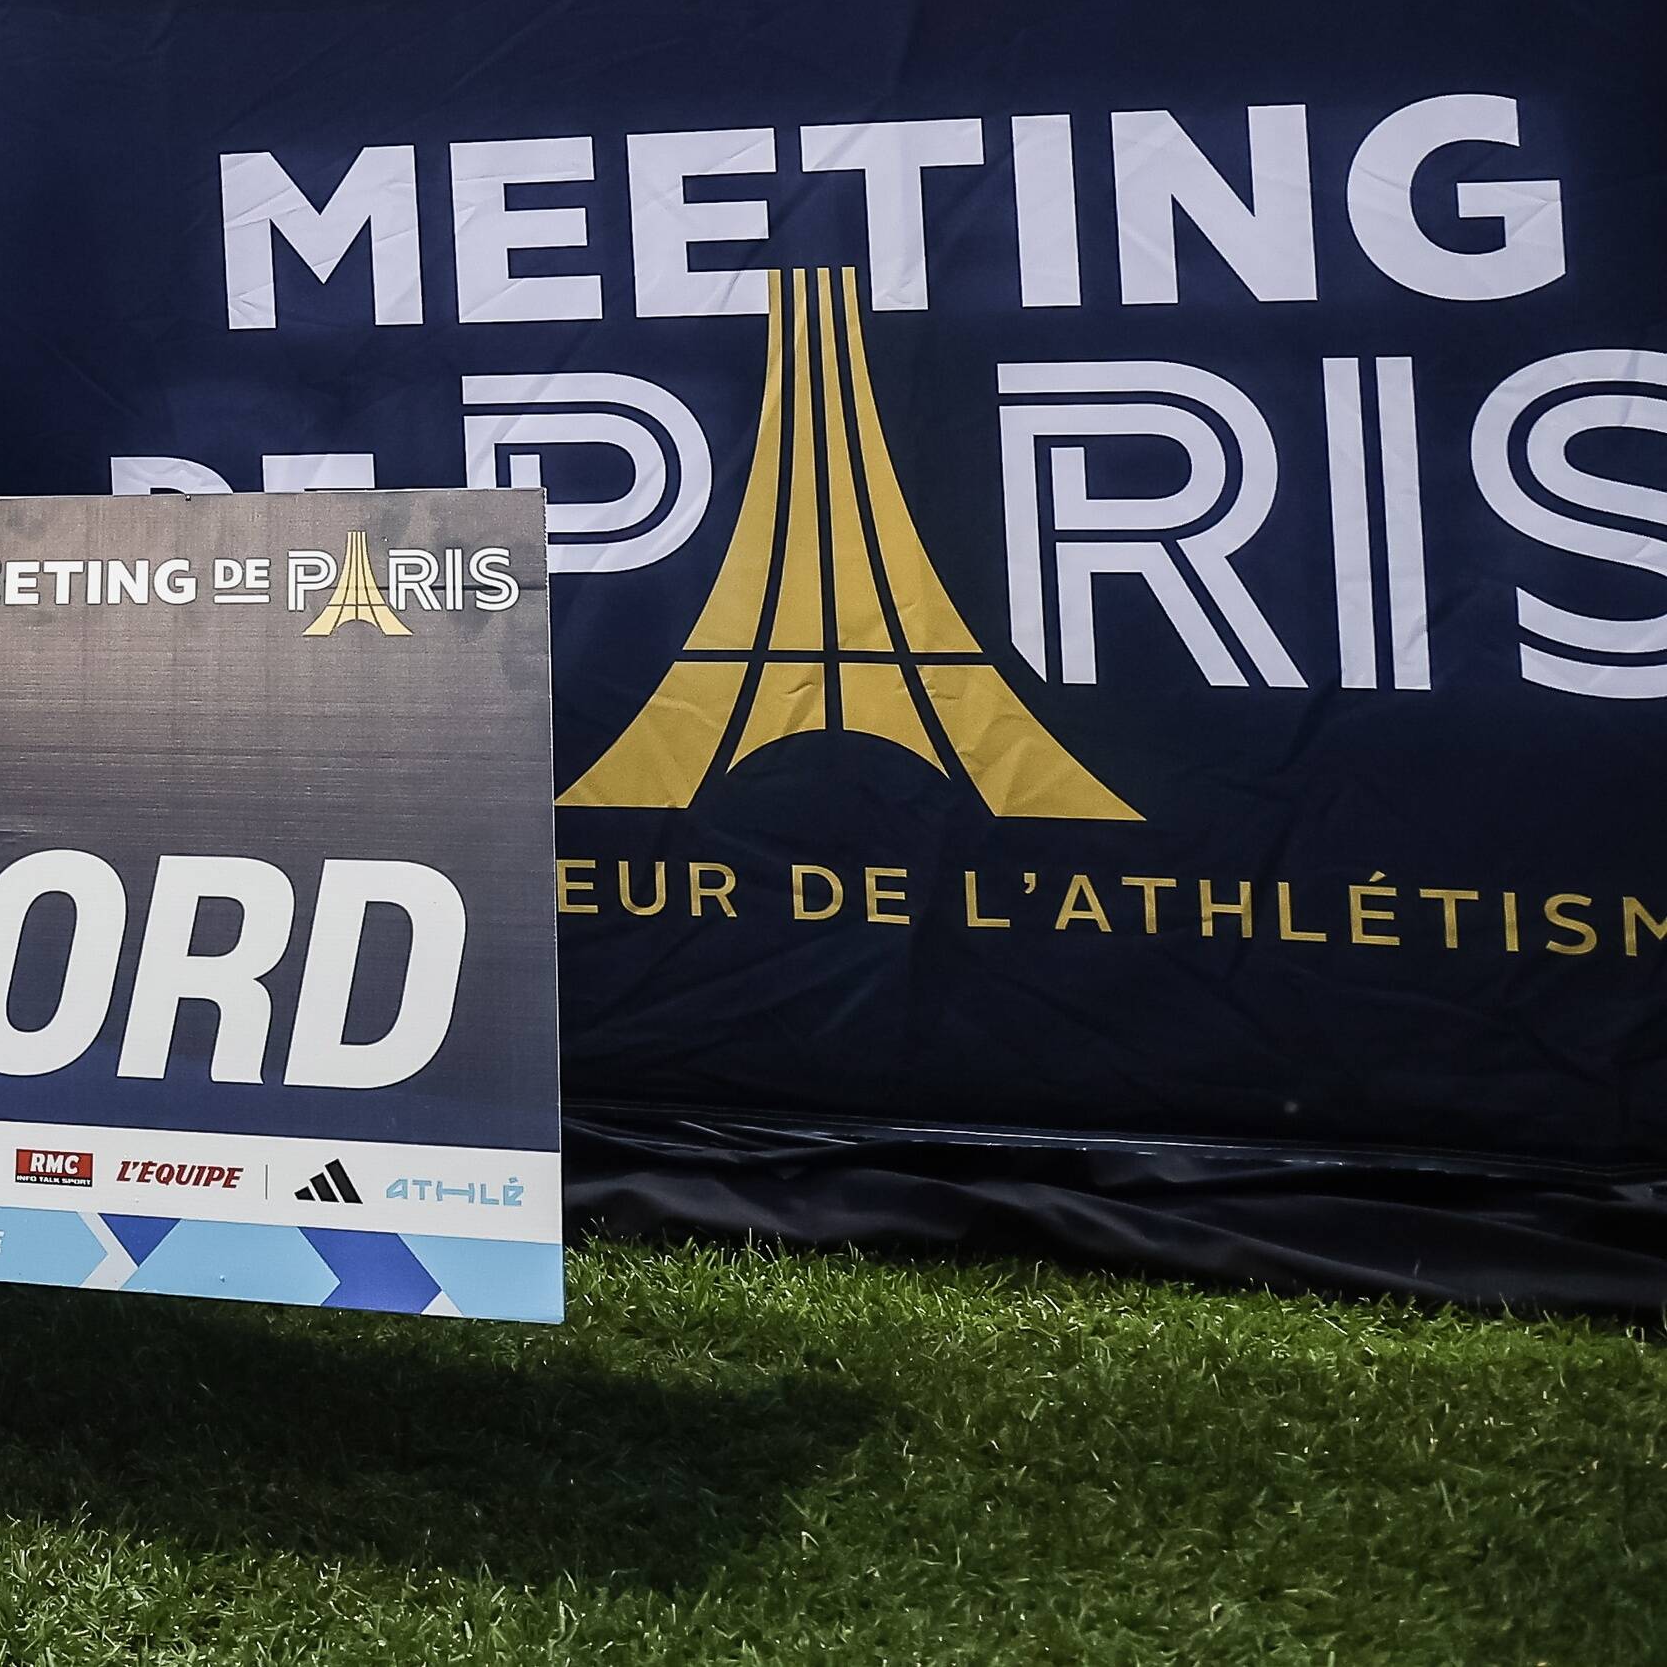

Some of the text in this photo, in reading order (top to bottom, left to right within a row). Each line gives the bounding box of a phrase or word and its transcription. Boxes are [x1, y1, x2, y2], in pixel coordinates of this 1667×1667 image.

[219, 93, 1566, 330] MEETING
[214, 559, 270, 589] DE
[288, 531, 520, 636] PARIS
[556, 859, 737, 918] EUR
[792, 864, 910, 925] DE
[30, 1152, 79, 1174] RMC
